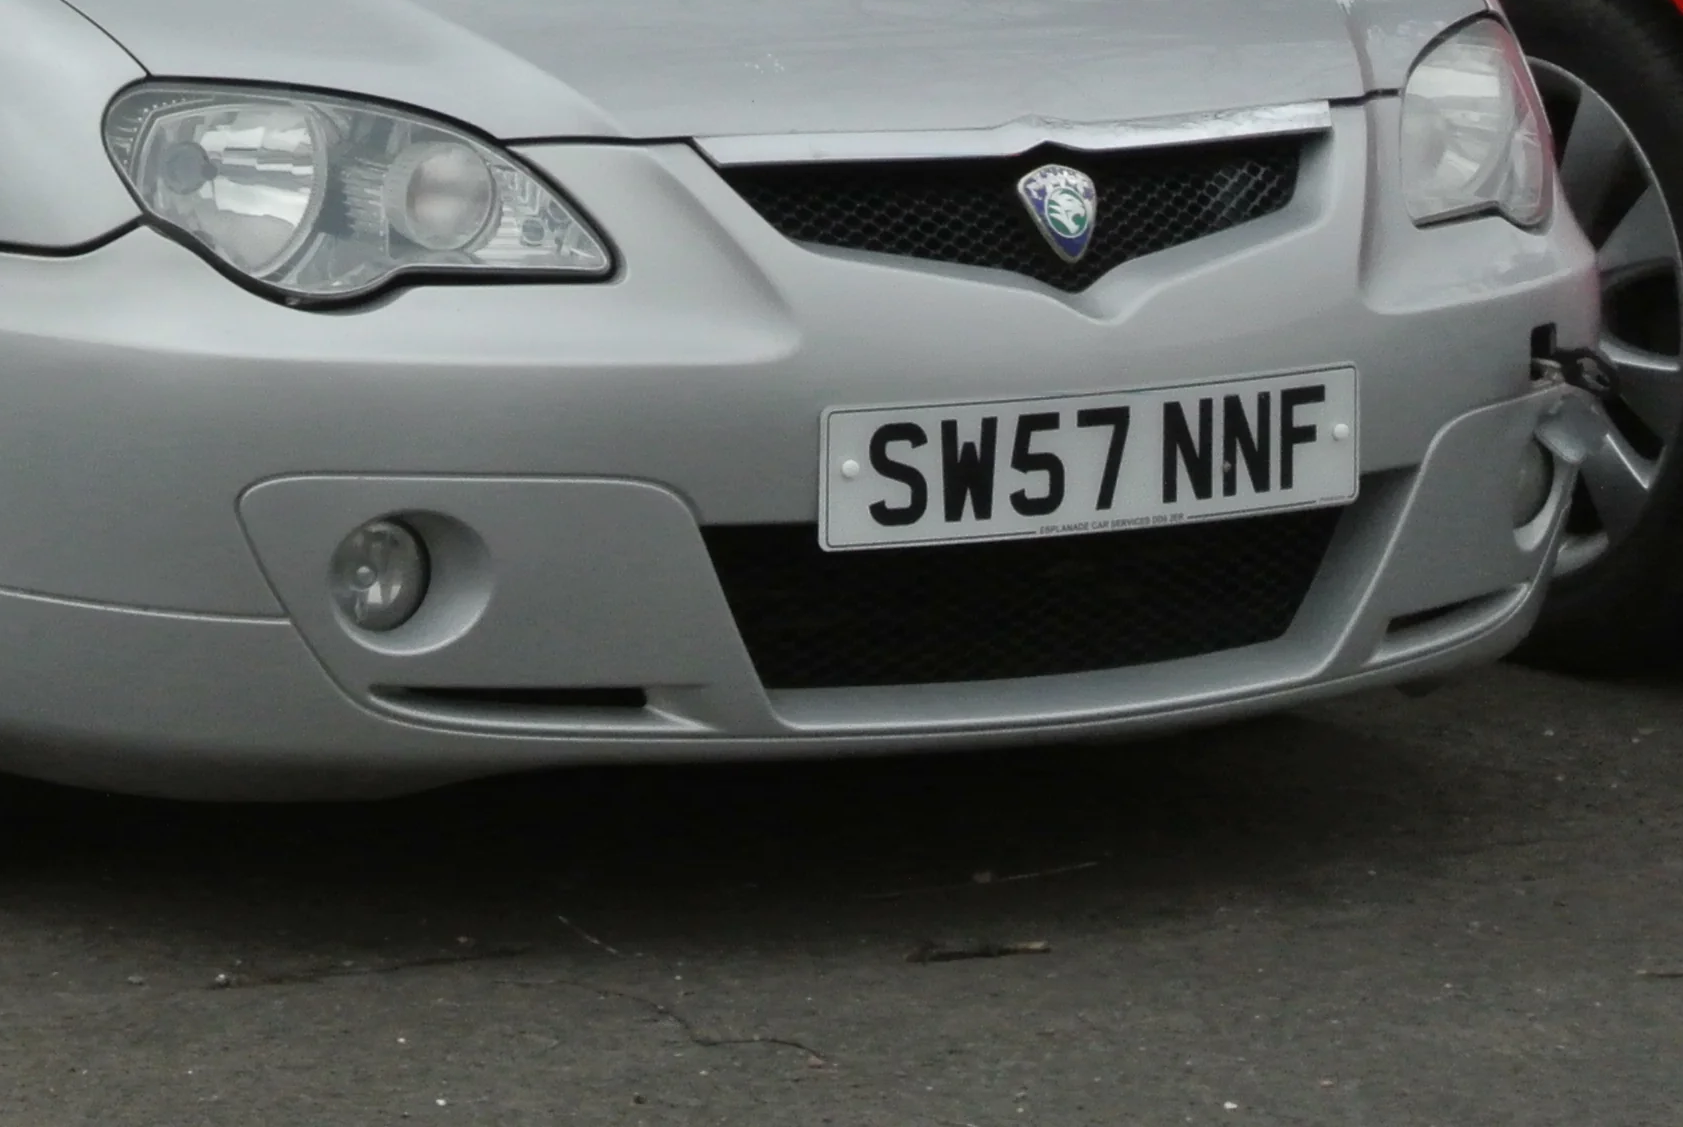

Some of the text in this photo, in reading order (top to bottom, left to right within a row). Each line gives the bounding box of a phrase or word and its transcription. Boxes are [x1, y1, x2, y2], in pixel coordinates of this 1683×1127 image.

[868, 384, 1326, 527] SW57 NNF
[1039, 521, 1089, 534] ESPLANADE
[1091, 519, 1109, 529] CAR
[1111, 516, 1150, 528] SERVICES
